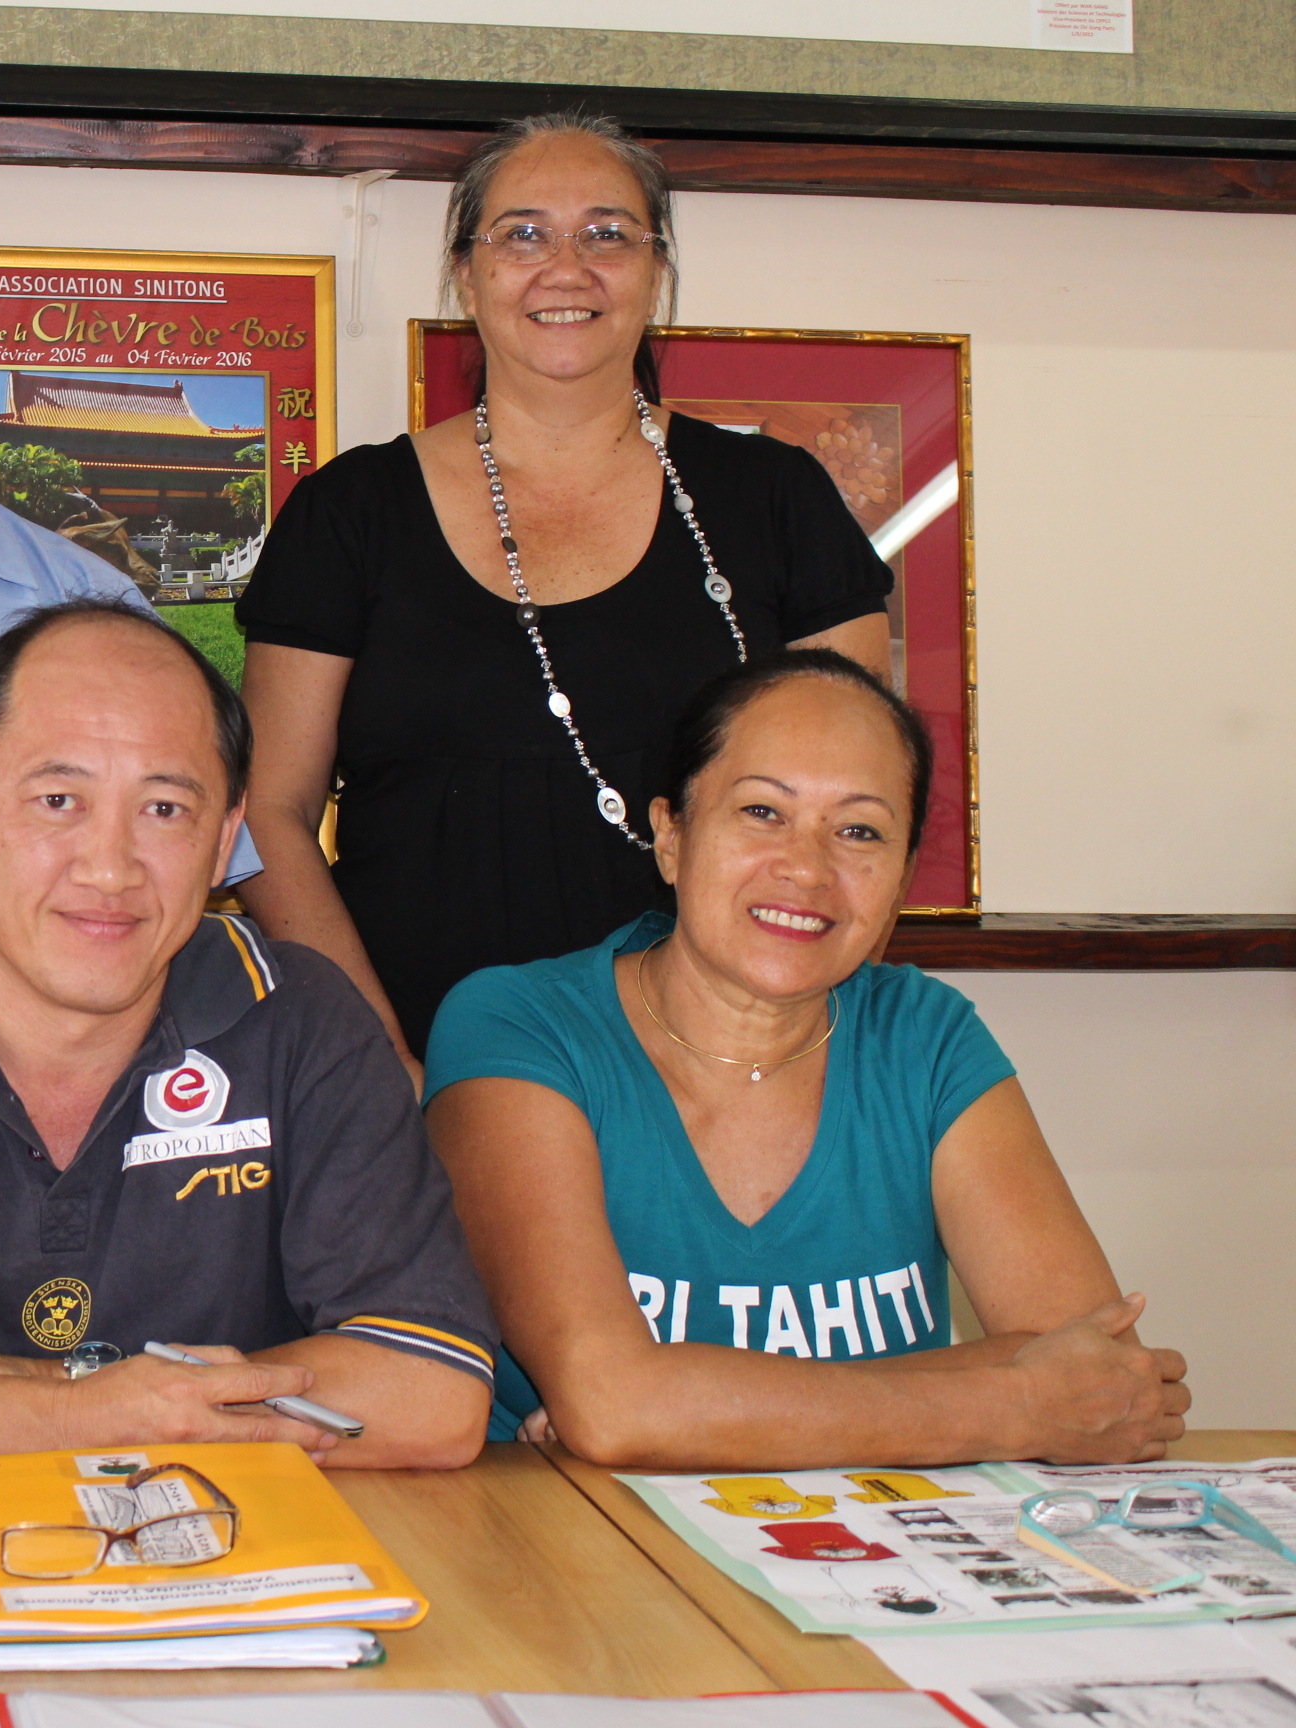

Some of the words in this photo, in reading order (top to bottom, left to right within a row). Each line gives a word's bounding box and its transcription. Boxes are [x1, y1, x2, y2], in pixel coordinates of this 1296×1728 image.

[134, 279, 225, 298] SINITONG
[14, 322, 27, 341] la
[32, 302, 179, 346] Chèvre
[190, 315, 220, 347] de
[229, 317, 307, 349] Bois
[49, 347, 87, 363] 2015
[95, 353, 113, 364] au
[128, 350, 150, 365] 04
[154, 350, 211, 366] Février
[216, 352, 252, 367] 2016
[176, 1161, 272, 1201] STIG
[37, 1280, 83, 1297] SVENSKA
[718, 1261, 935, 1358] TAHITI
[145, 1581, 213, 1594] TUPUNA
[218, 1575, 276, 1588] VARUA
[264, 1575, 355, 1590] Association
[125, 1590, 228, 1604] Descendants
[232, 1586, 259, 1595] des
[100, 1597, 120, 1605] de
